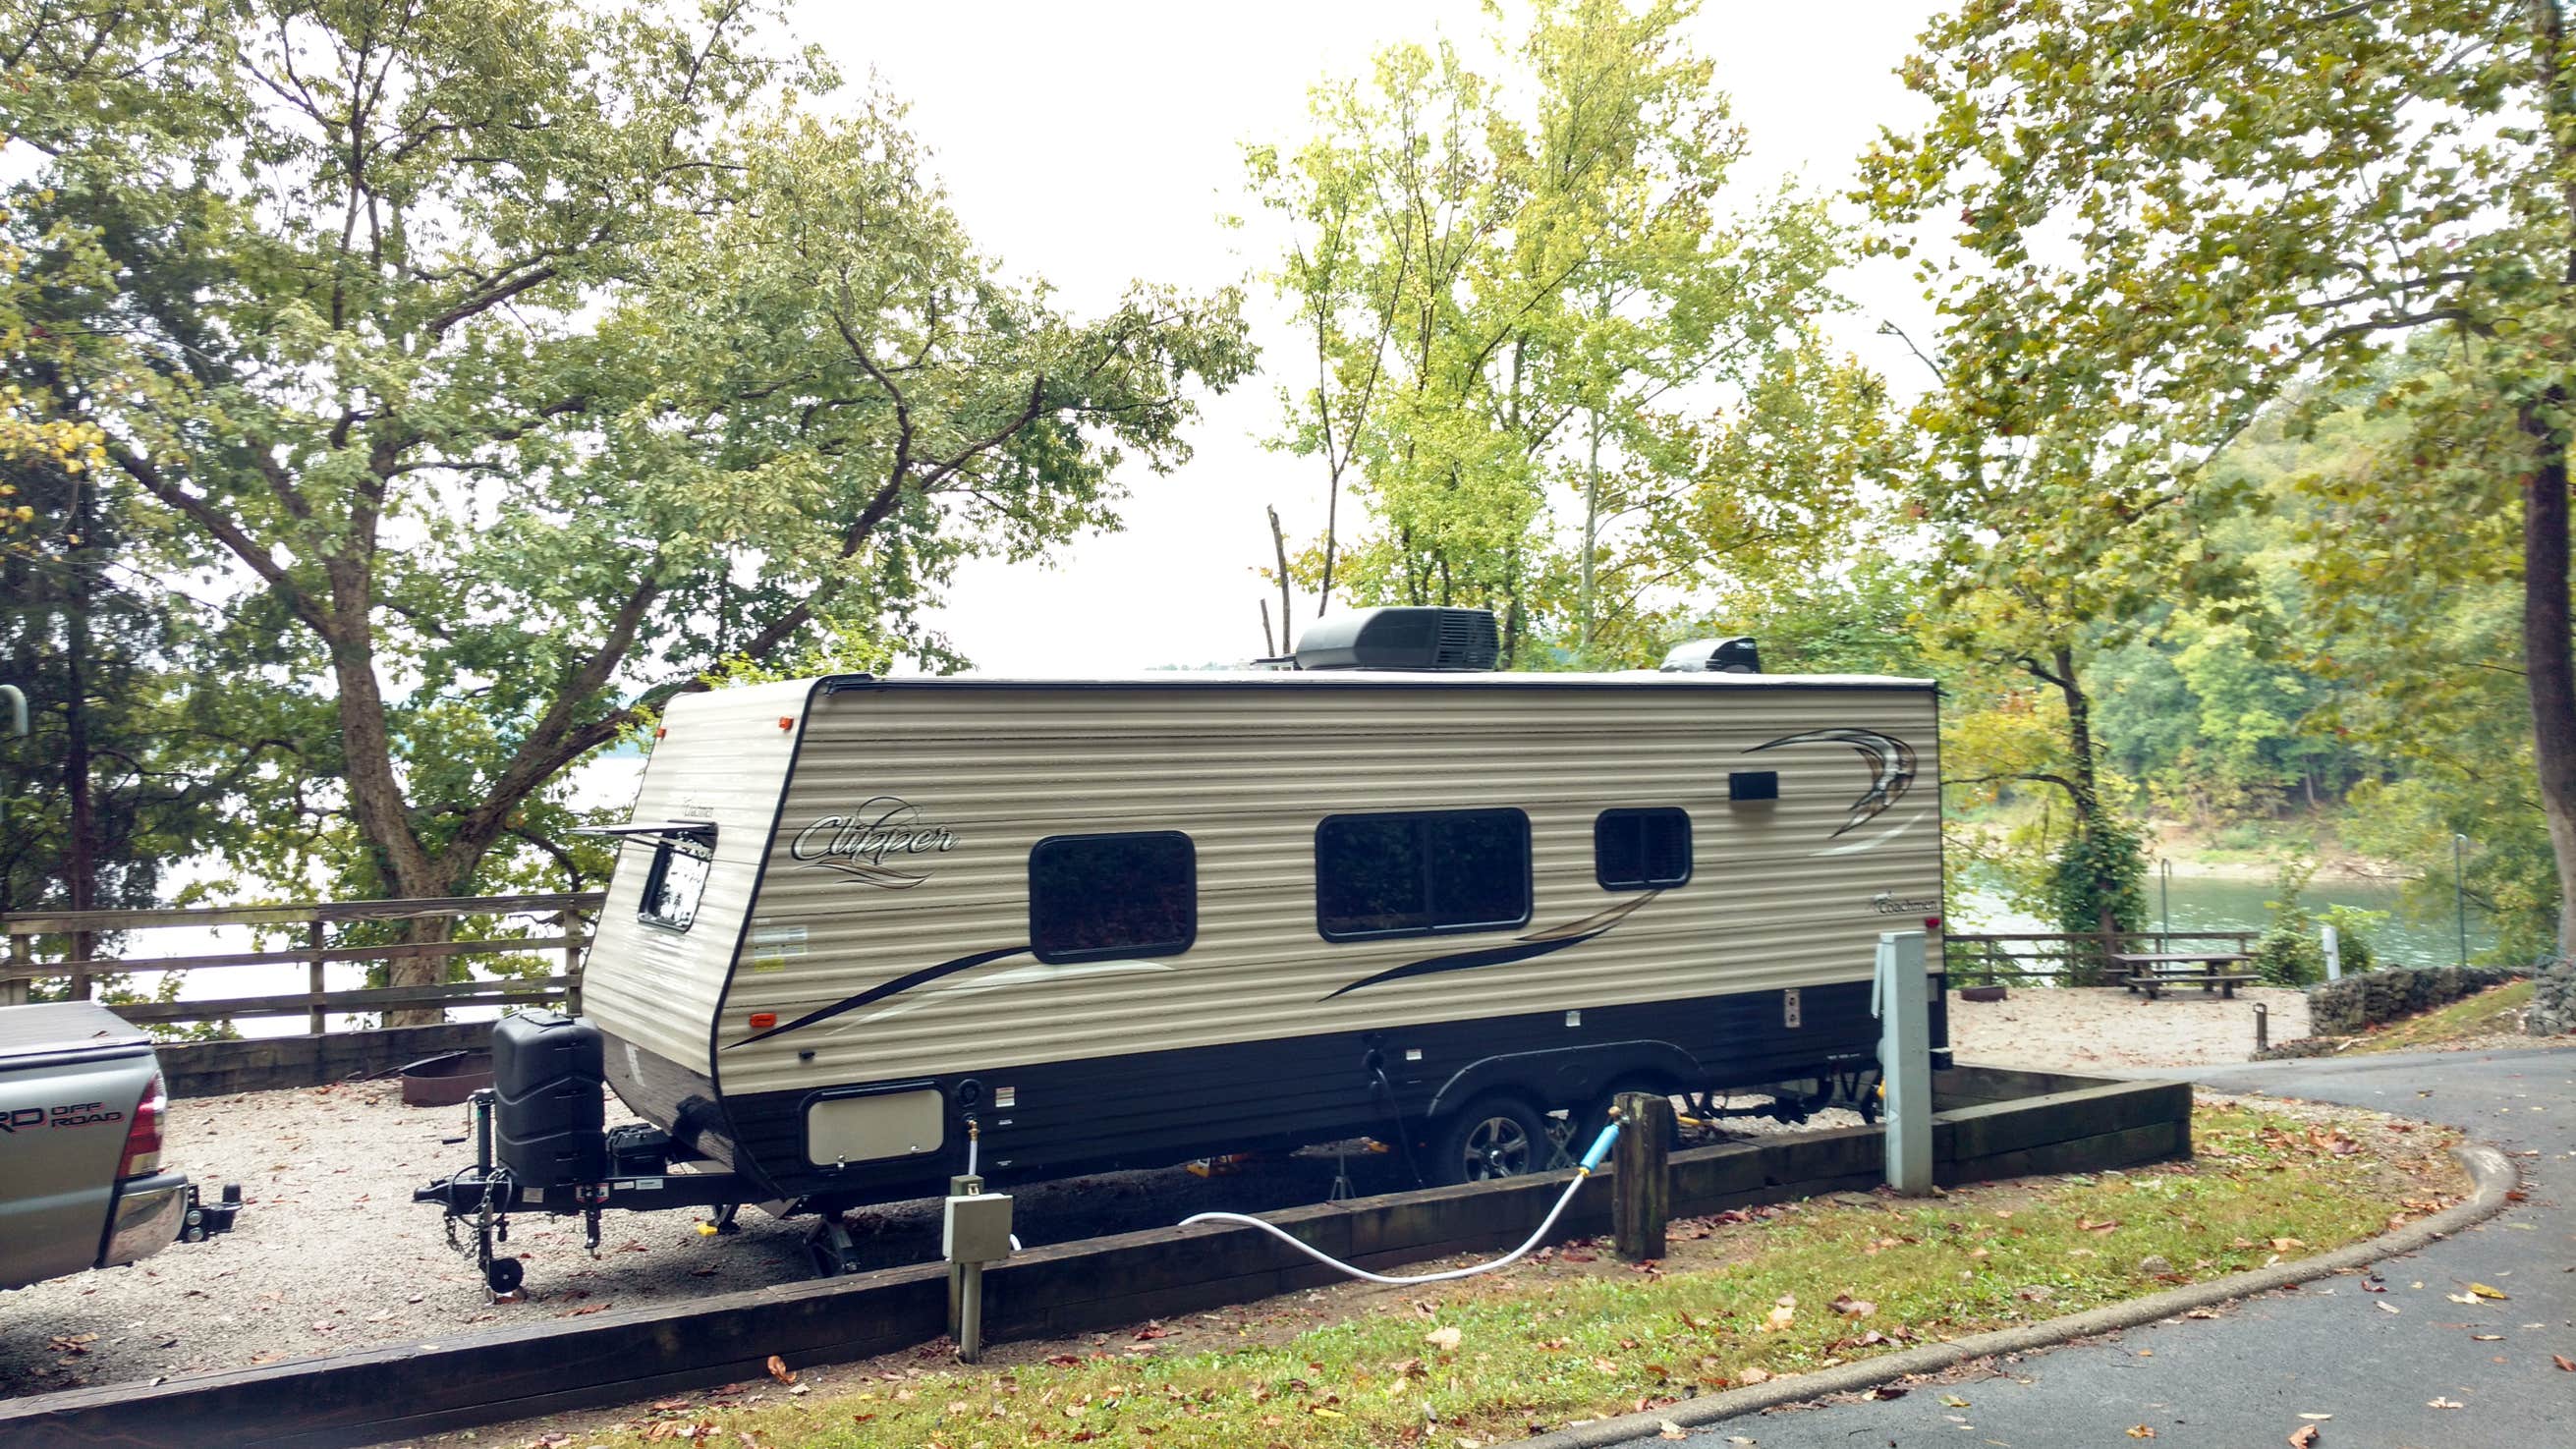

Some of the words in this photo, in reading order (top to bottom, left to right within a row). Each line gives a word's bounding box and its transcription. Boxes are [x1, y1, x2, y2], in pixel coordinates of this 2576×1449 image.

[791, 796, 960, 865] Clipper
[51, 1102, 103, 1115] OFF
[51, 1112, 123, 1128] ROAD
